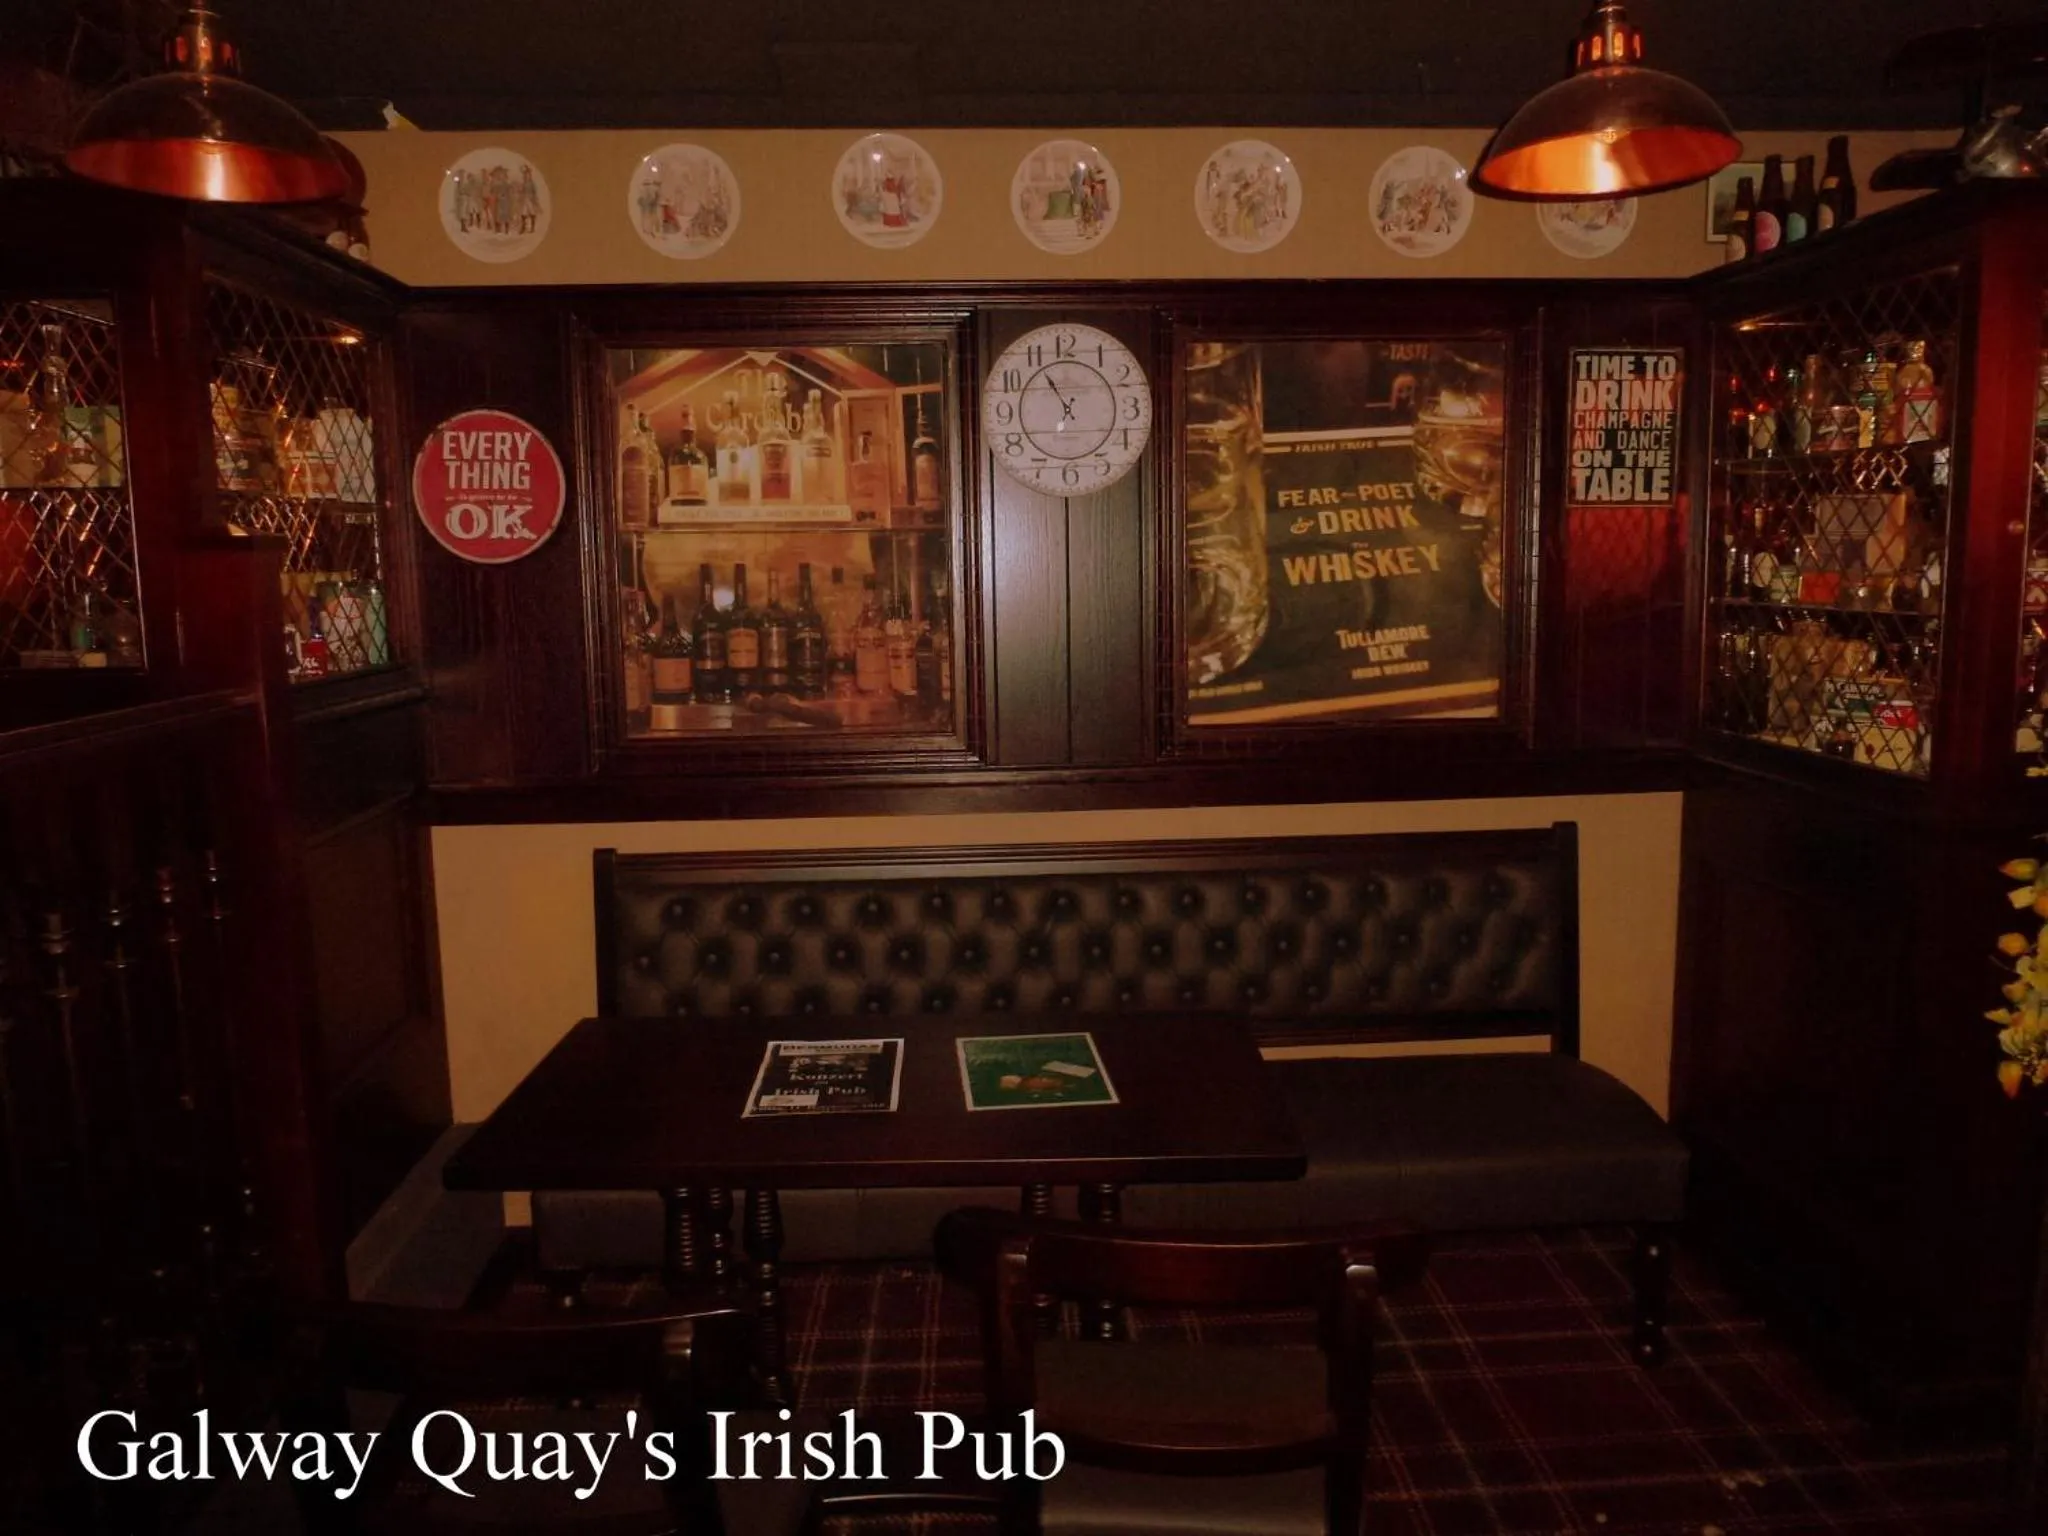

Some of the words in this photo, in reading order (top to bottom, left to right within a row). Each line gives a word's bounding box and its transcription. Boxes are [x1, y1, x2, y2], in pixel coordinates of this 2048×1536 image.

[1027, 344, 1042, 367] 11
[1056, 334, 1077, 359] 12
[1116, 364, 1131, 387] 2
[1575, 355, 1636, 380] TIME
[1640, 355, 1676, 380] TO
[1002, 368, 1021, 393] 10
[1575, 380, 1676, 410] DRINK
[996, 401, 1013, 426] 9
[1122, 396, 1140, 421] 3
[1573, 411, 1673, 430] CHAMPAGNE
[442, 430, 532, 461] EVERY
[1005, 432, 1024, 457] 8
[1111, 427, 1129, 451] 4
[1572, 430, 1606, 450] AND
[1616, 430, 1672, 450] DANCE
[1031, 457, 1047, 479] 7
[1094, 452, 1111, 476] 5
[1572, 450, 1612, 468] ON
[1621, 450, 1671, 468] THE
[444, 461, 531, 490] THING
[1062, 462, 1079, 486] 6
[1571, 468, 1670, 502] TABLE
[1277, 487, 1340, 508] FEAR
[1357, 482, 1416, 501] POET
[445, 503, 538, 540] OK
[1318, 505, 1420, 535] DRINK
[1281, 544, 1440, 587] WHISKEY
